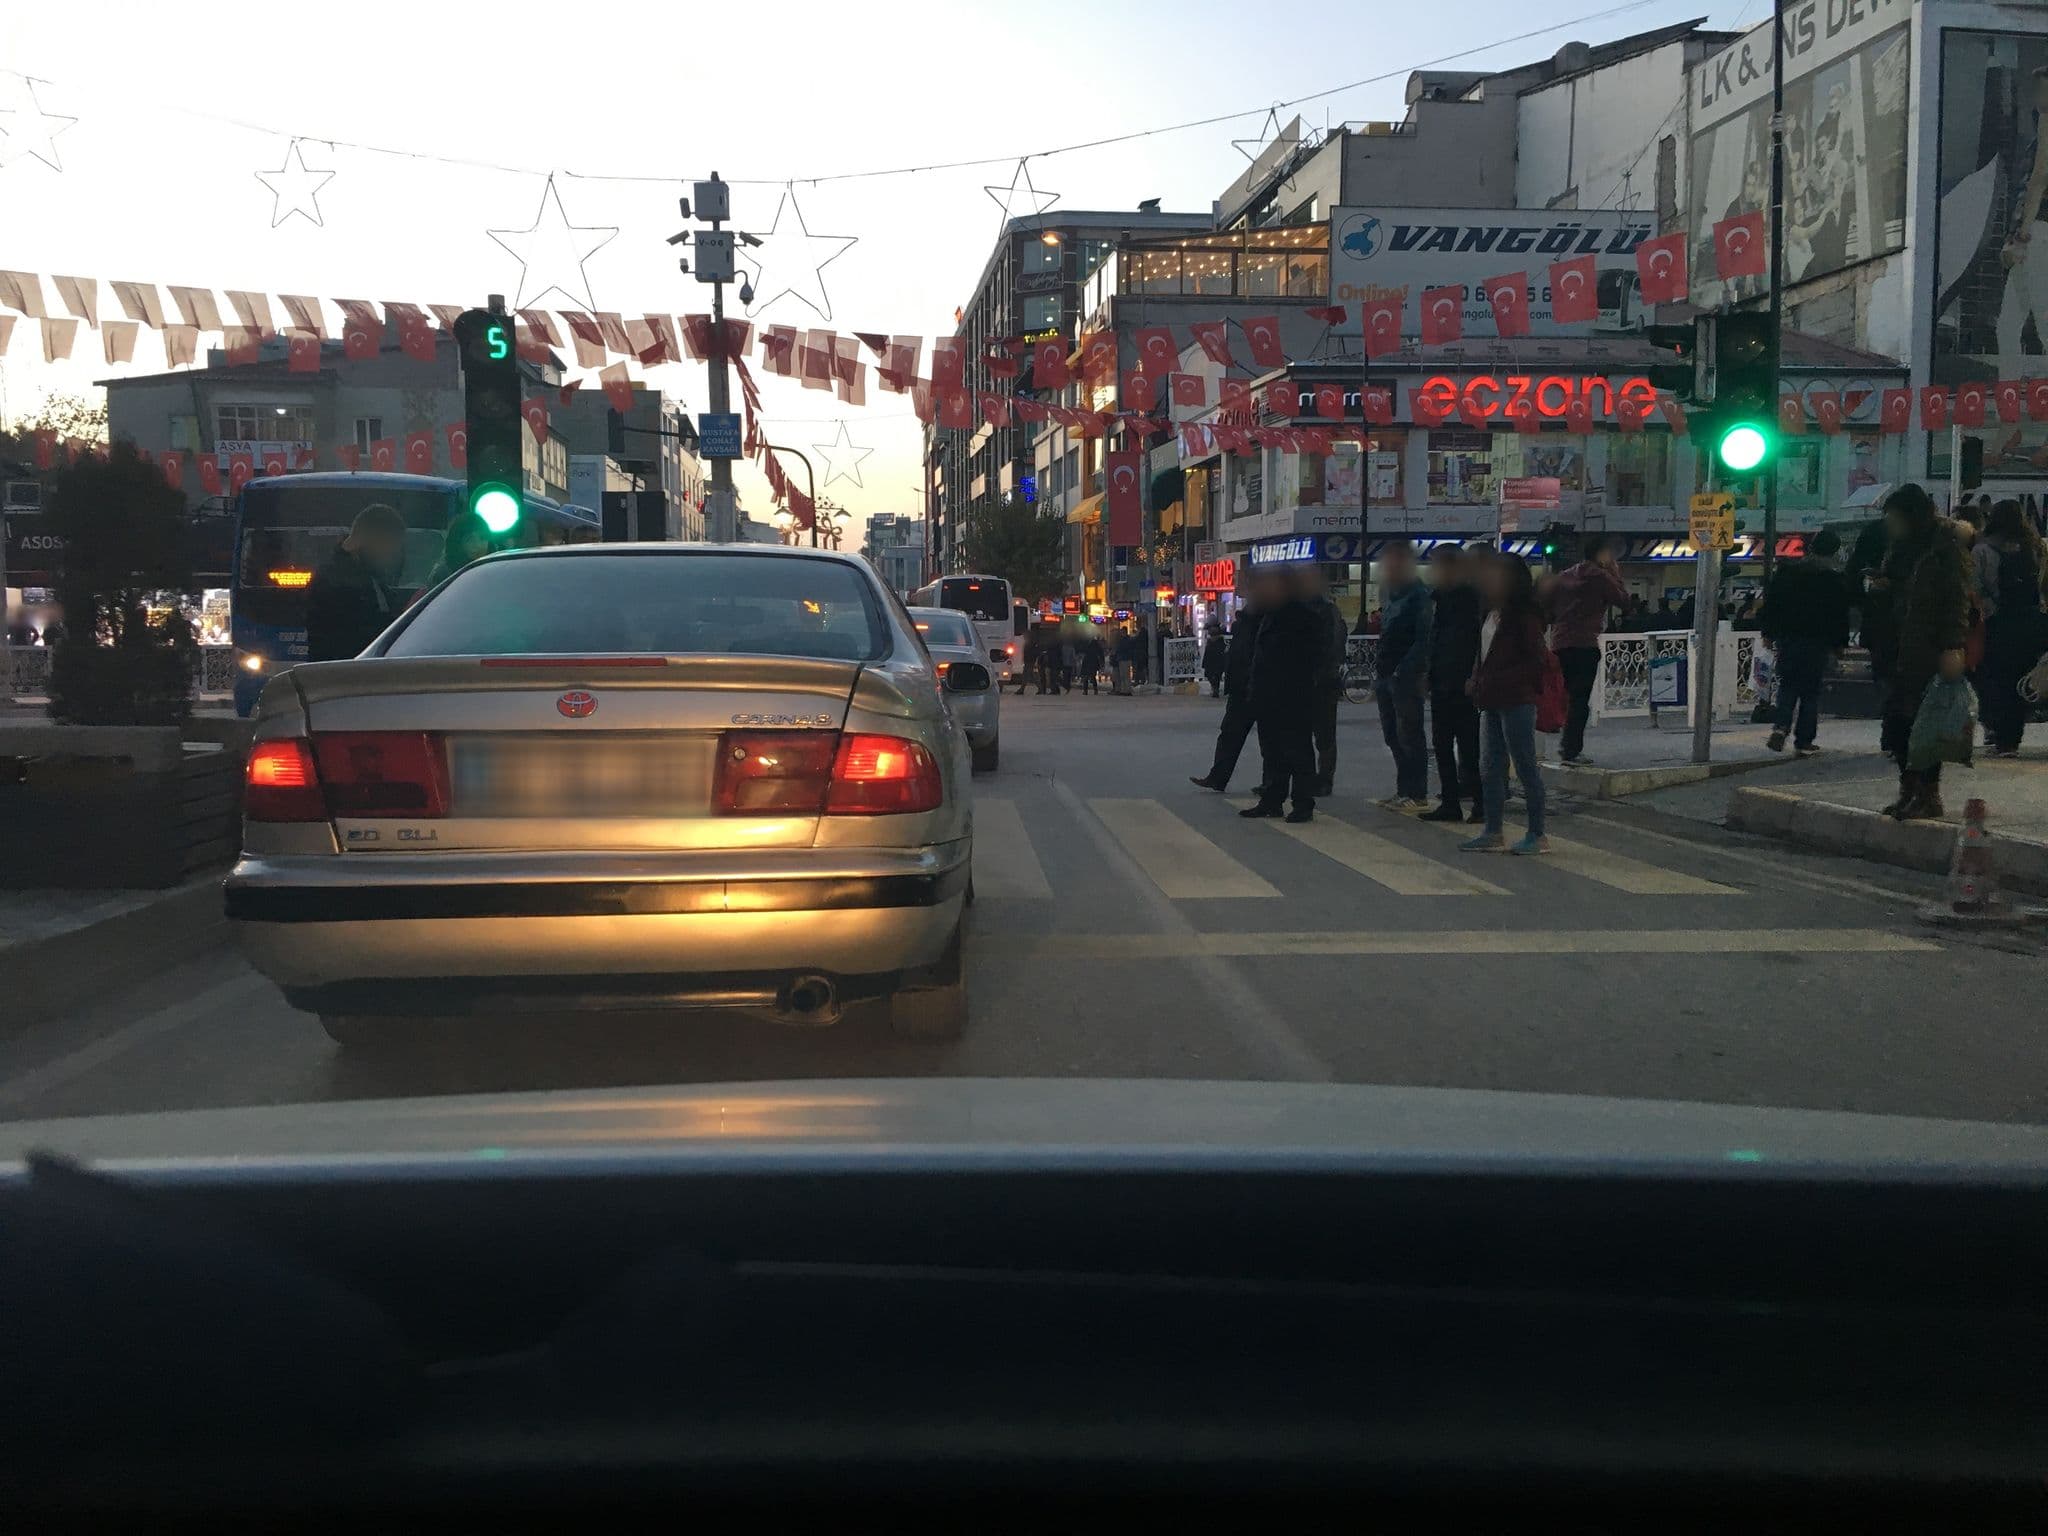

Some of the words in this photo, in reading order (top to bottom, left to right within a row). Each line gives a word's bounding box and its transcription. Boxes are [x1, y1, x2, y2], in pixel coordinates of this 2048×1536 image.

[1388, 223, 1652, 254] VANGÖLÜ
[488, 327, 507, 358] 5
[1420, 376, 1658, 418] eczane
[219, 441, 252, 451] ASYA
[1195, 559, 1234, 588] eczane
